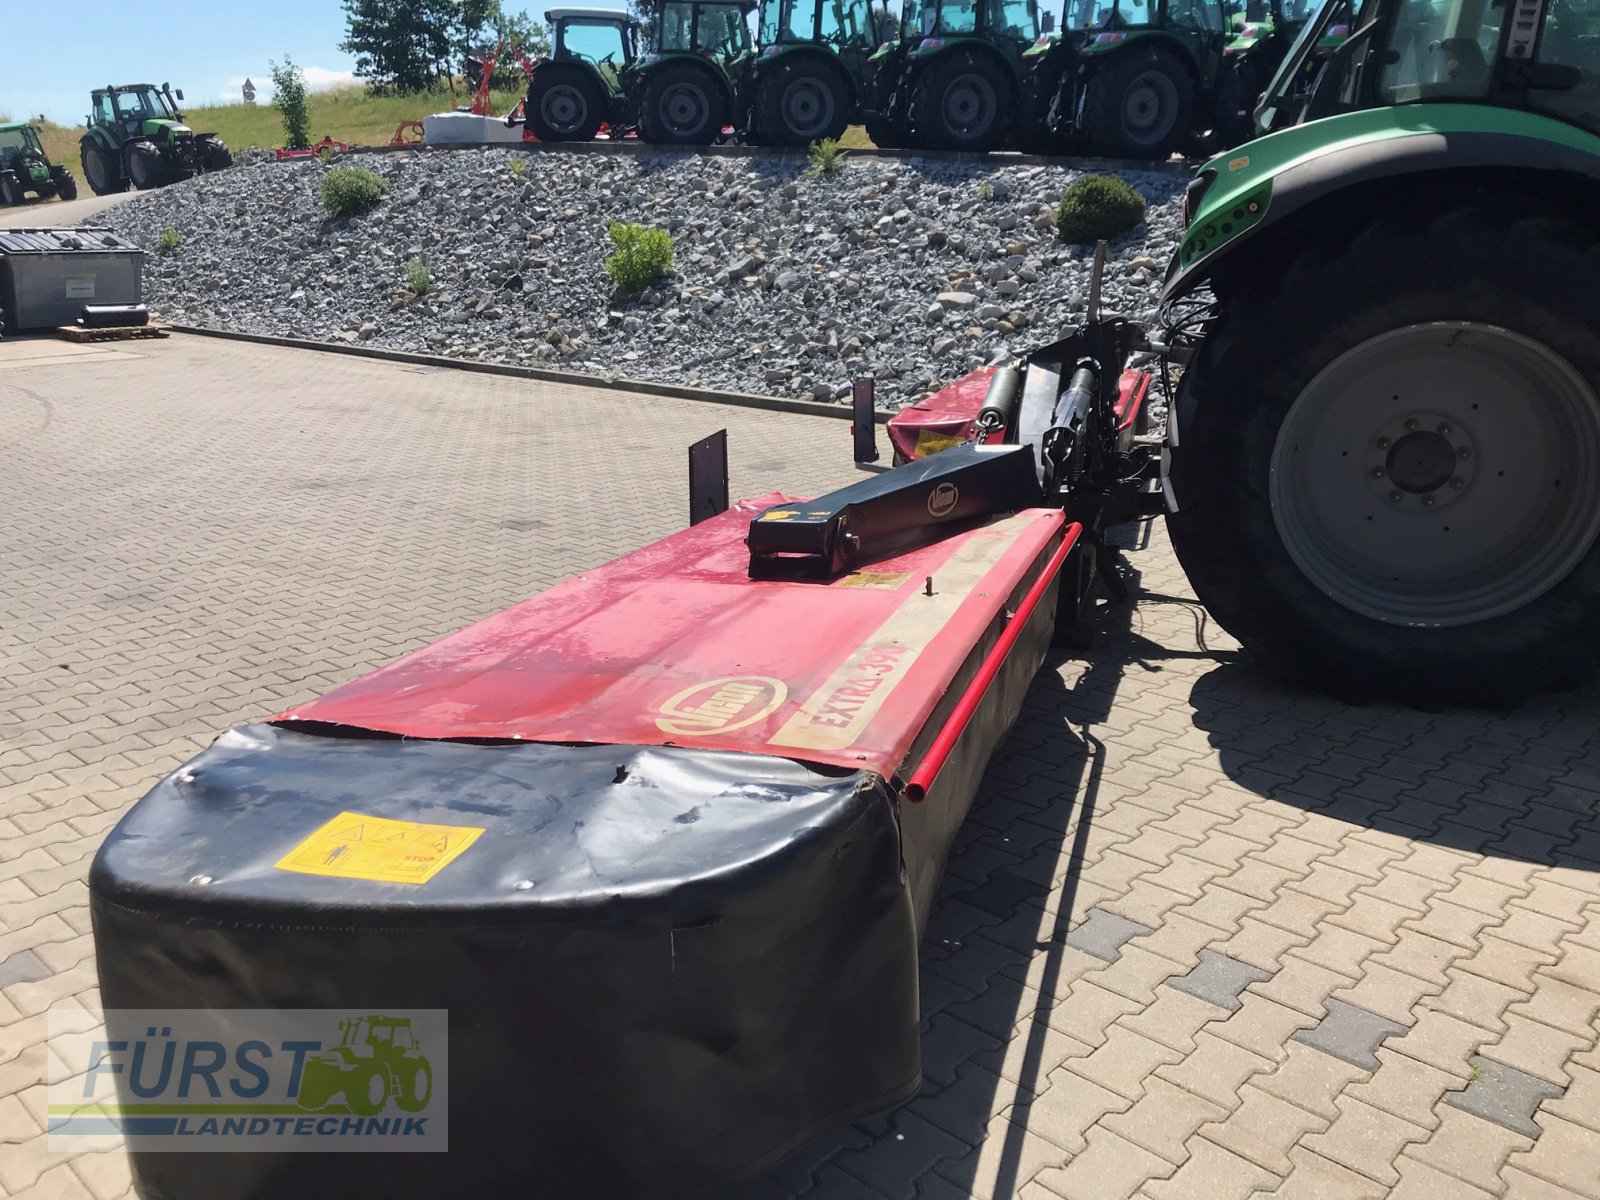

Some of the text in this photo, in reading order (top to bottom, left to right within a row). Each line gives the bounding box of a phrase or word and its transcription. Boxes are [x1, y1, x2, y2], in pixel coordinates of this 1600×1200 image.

[809, 645, 907, 728] EXTRA 390
[403, 854, 436, 863] STOP
